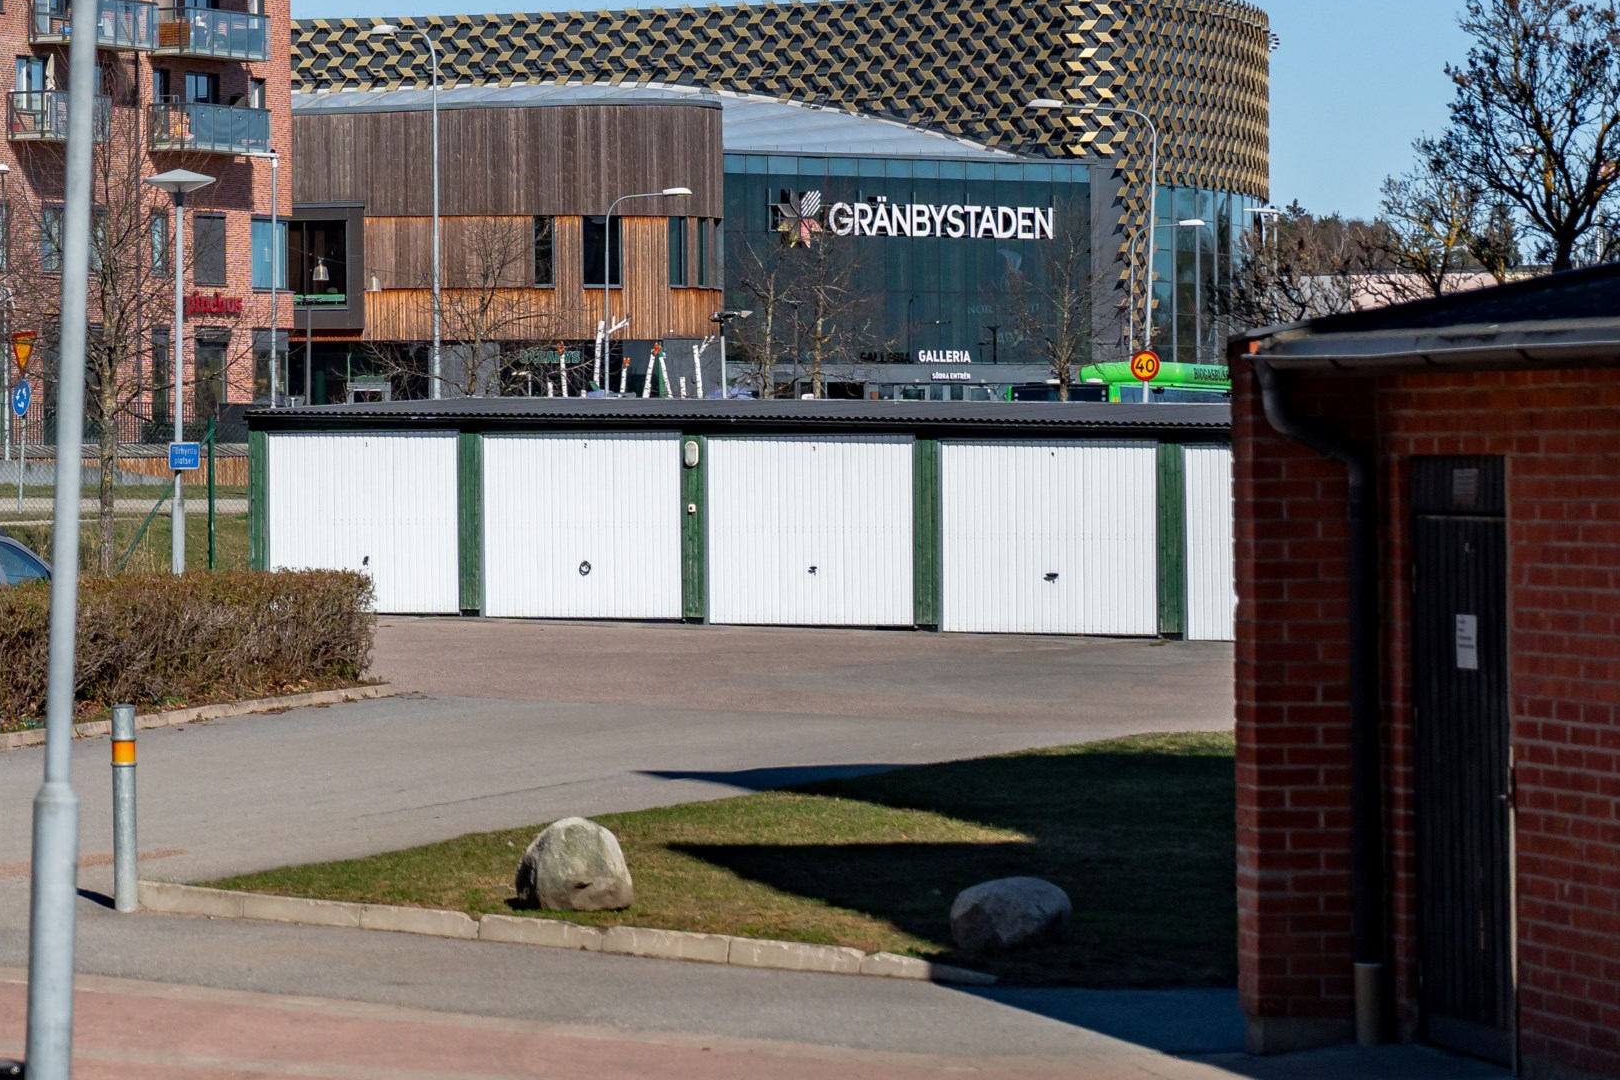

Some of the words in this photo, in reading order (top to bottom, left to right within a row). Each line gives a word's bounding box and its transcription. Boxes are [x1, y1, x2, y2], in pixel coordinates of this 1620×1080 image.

[829, 196, 1054, 240] GRÄNBYSTADEN
[918, 350, 972, 363] GALLERIA
[1135, 358, 1155, 373] 40
[174, 457, 195, 466] platser
